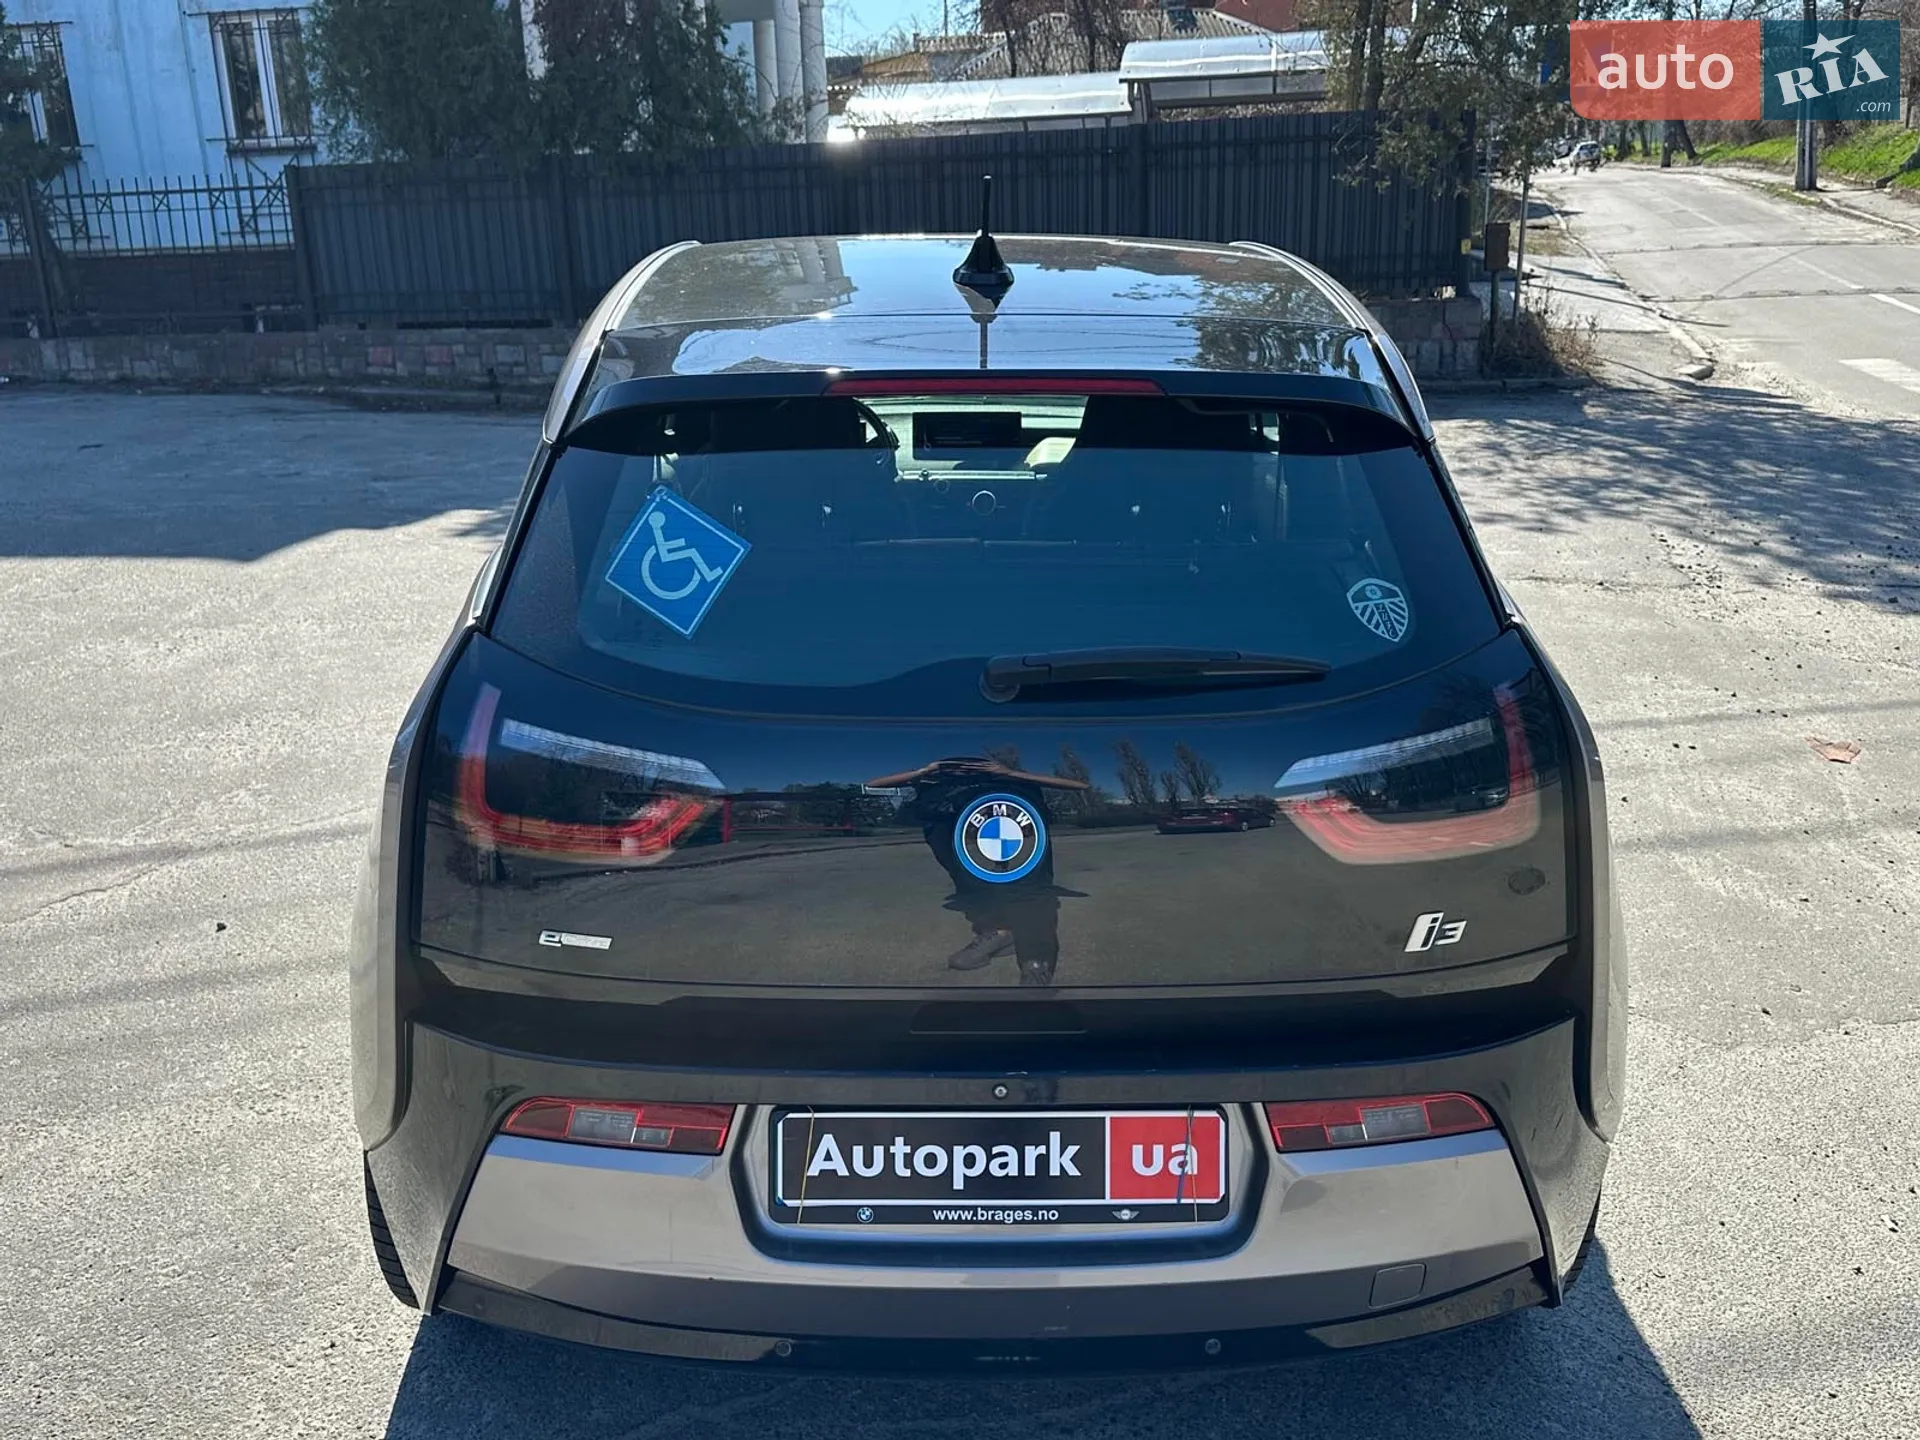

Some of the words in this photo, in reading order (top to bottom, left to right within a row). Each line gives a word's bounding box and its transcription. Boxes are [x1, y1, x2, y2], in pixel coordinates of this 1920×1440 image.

[970, 804, 1031, 828] BMW
[1404, 912, 1467, 952] i3
[807, 1131, 1081, 1189] Autopark
[1131, 1143, 1198, 1176] ua
[933, 1207, 1059, 1223] www.brages.no
